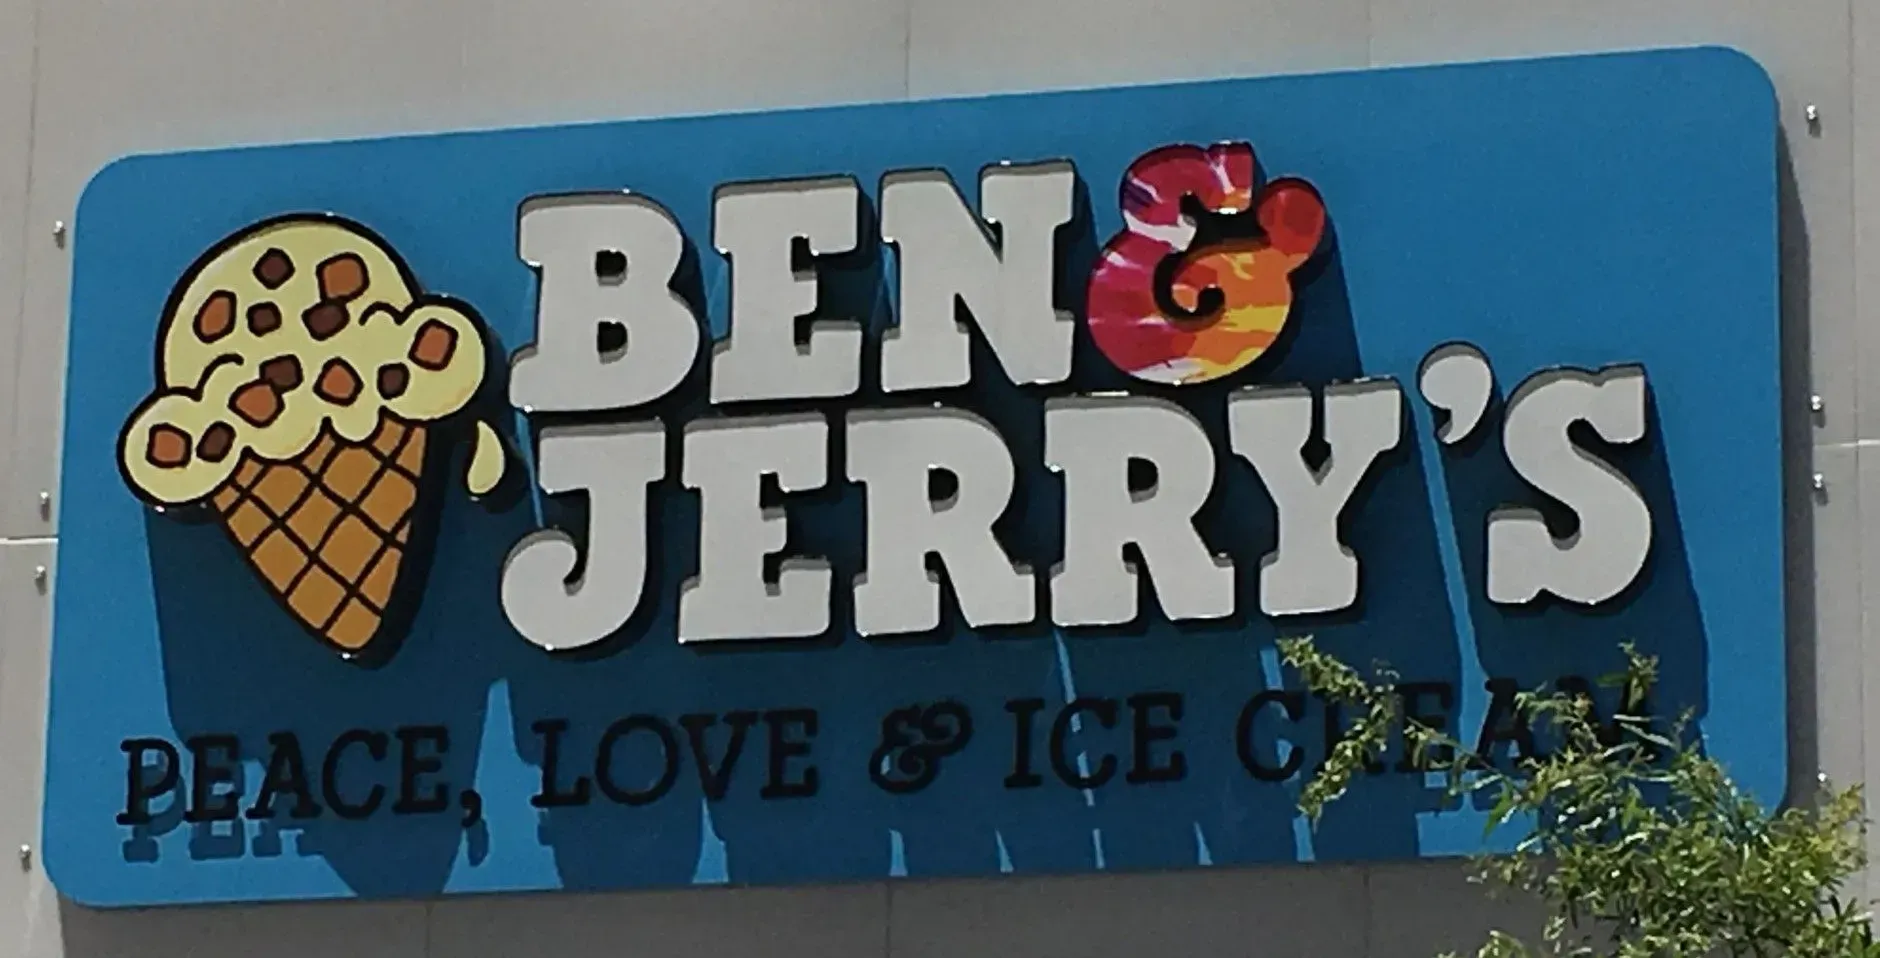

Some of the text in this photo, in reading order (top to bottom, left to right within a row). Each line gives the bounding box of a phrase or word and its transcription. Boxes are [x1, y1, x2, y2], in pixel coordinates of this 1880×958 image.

[508, 140, 1326, 412] BEN &
[500, 343, 1653, 652] JERRY'S
[115, 724, 483, 828] PEACE,
[531, 708, 819, 803] LOVE
[868, 700, 973, 795] &
[1003, 692, 1187, 790] ICE
